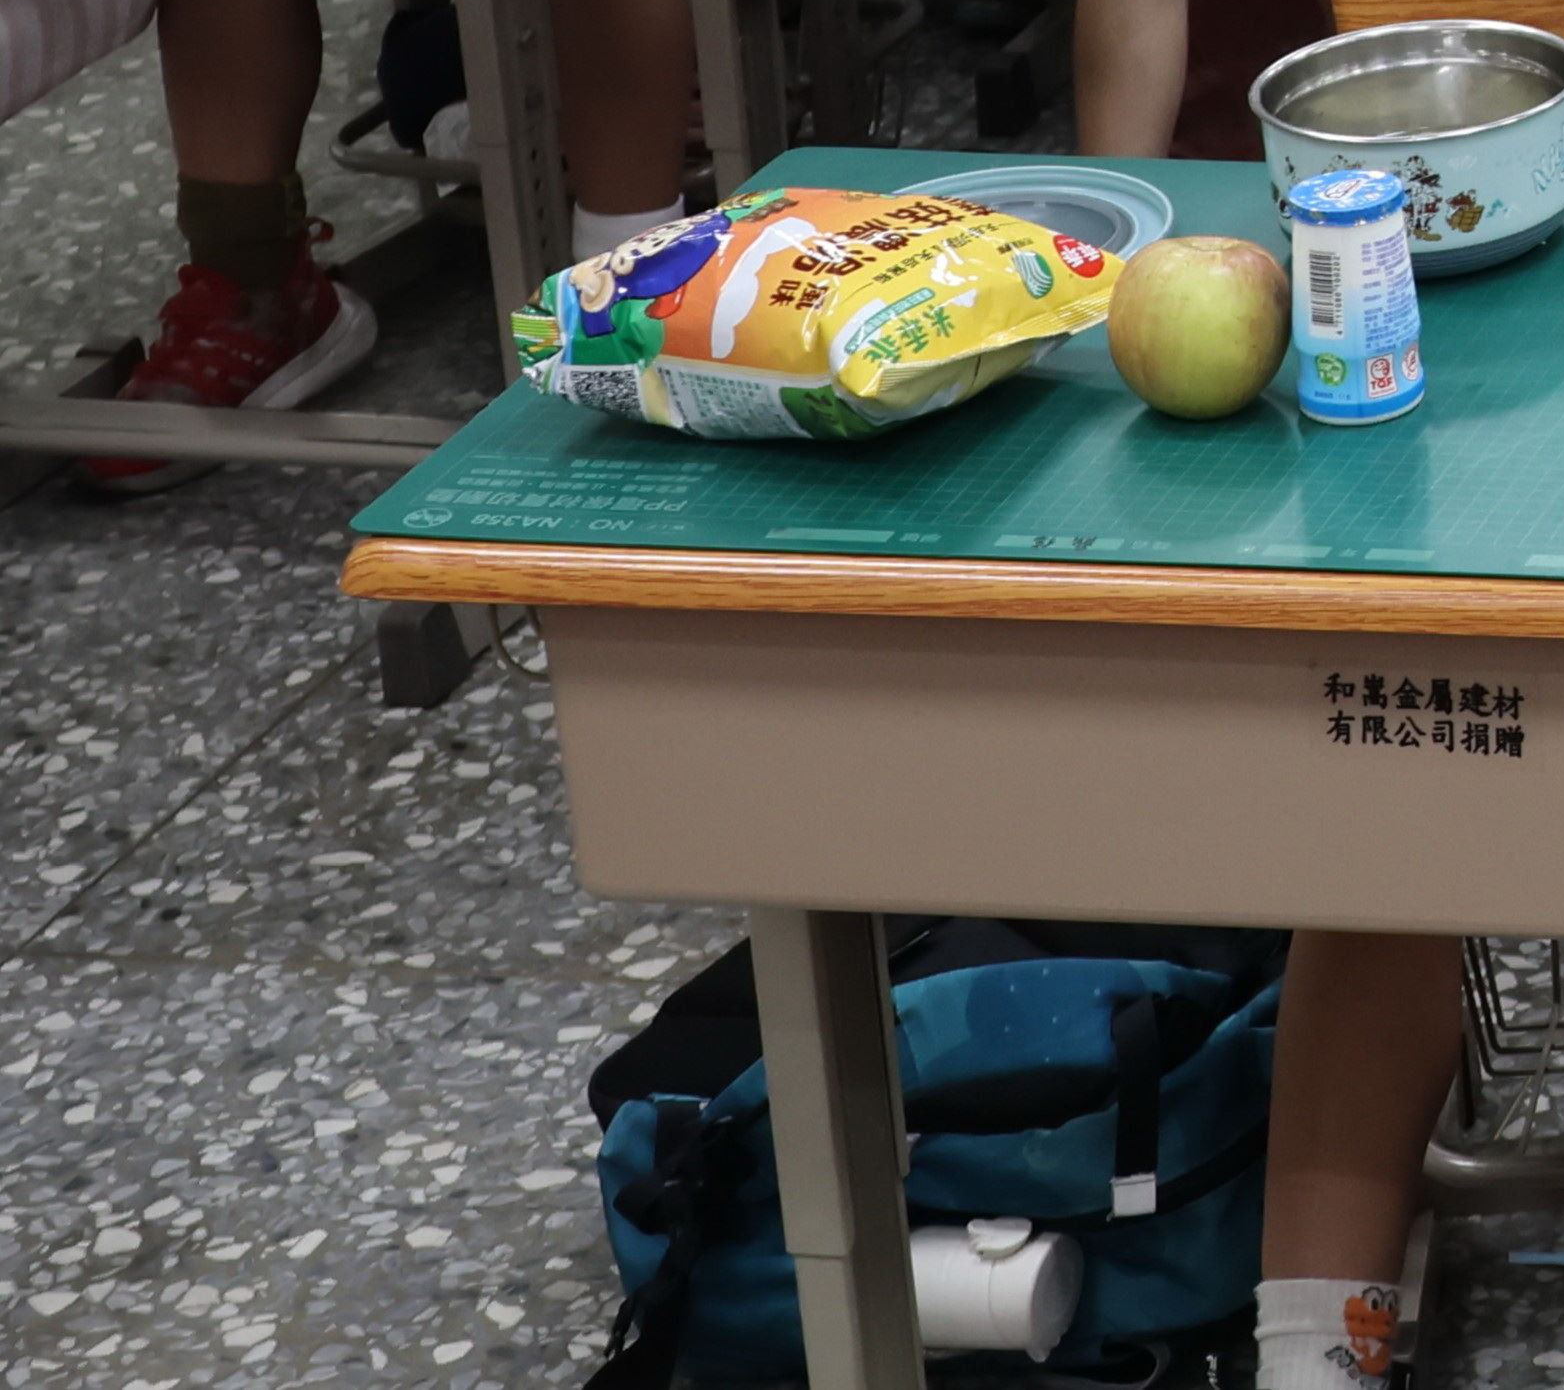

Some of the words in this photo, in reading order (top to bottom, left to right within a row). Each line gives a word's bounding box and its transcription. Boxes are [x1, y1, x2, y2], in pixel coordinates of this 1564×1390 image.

[469, 513, 563, 531] NA358
[1323, 673, 1526, 720] 和嵩金屬建材
[1323, 710, 1527, 759] 有限公司捐贈
